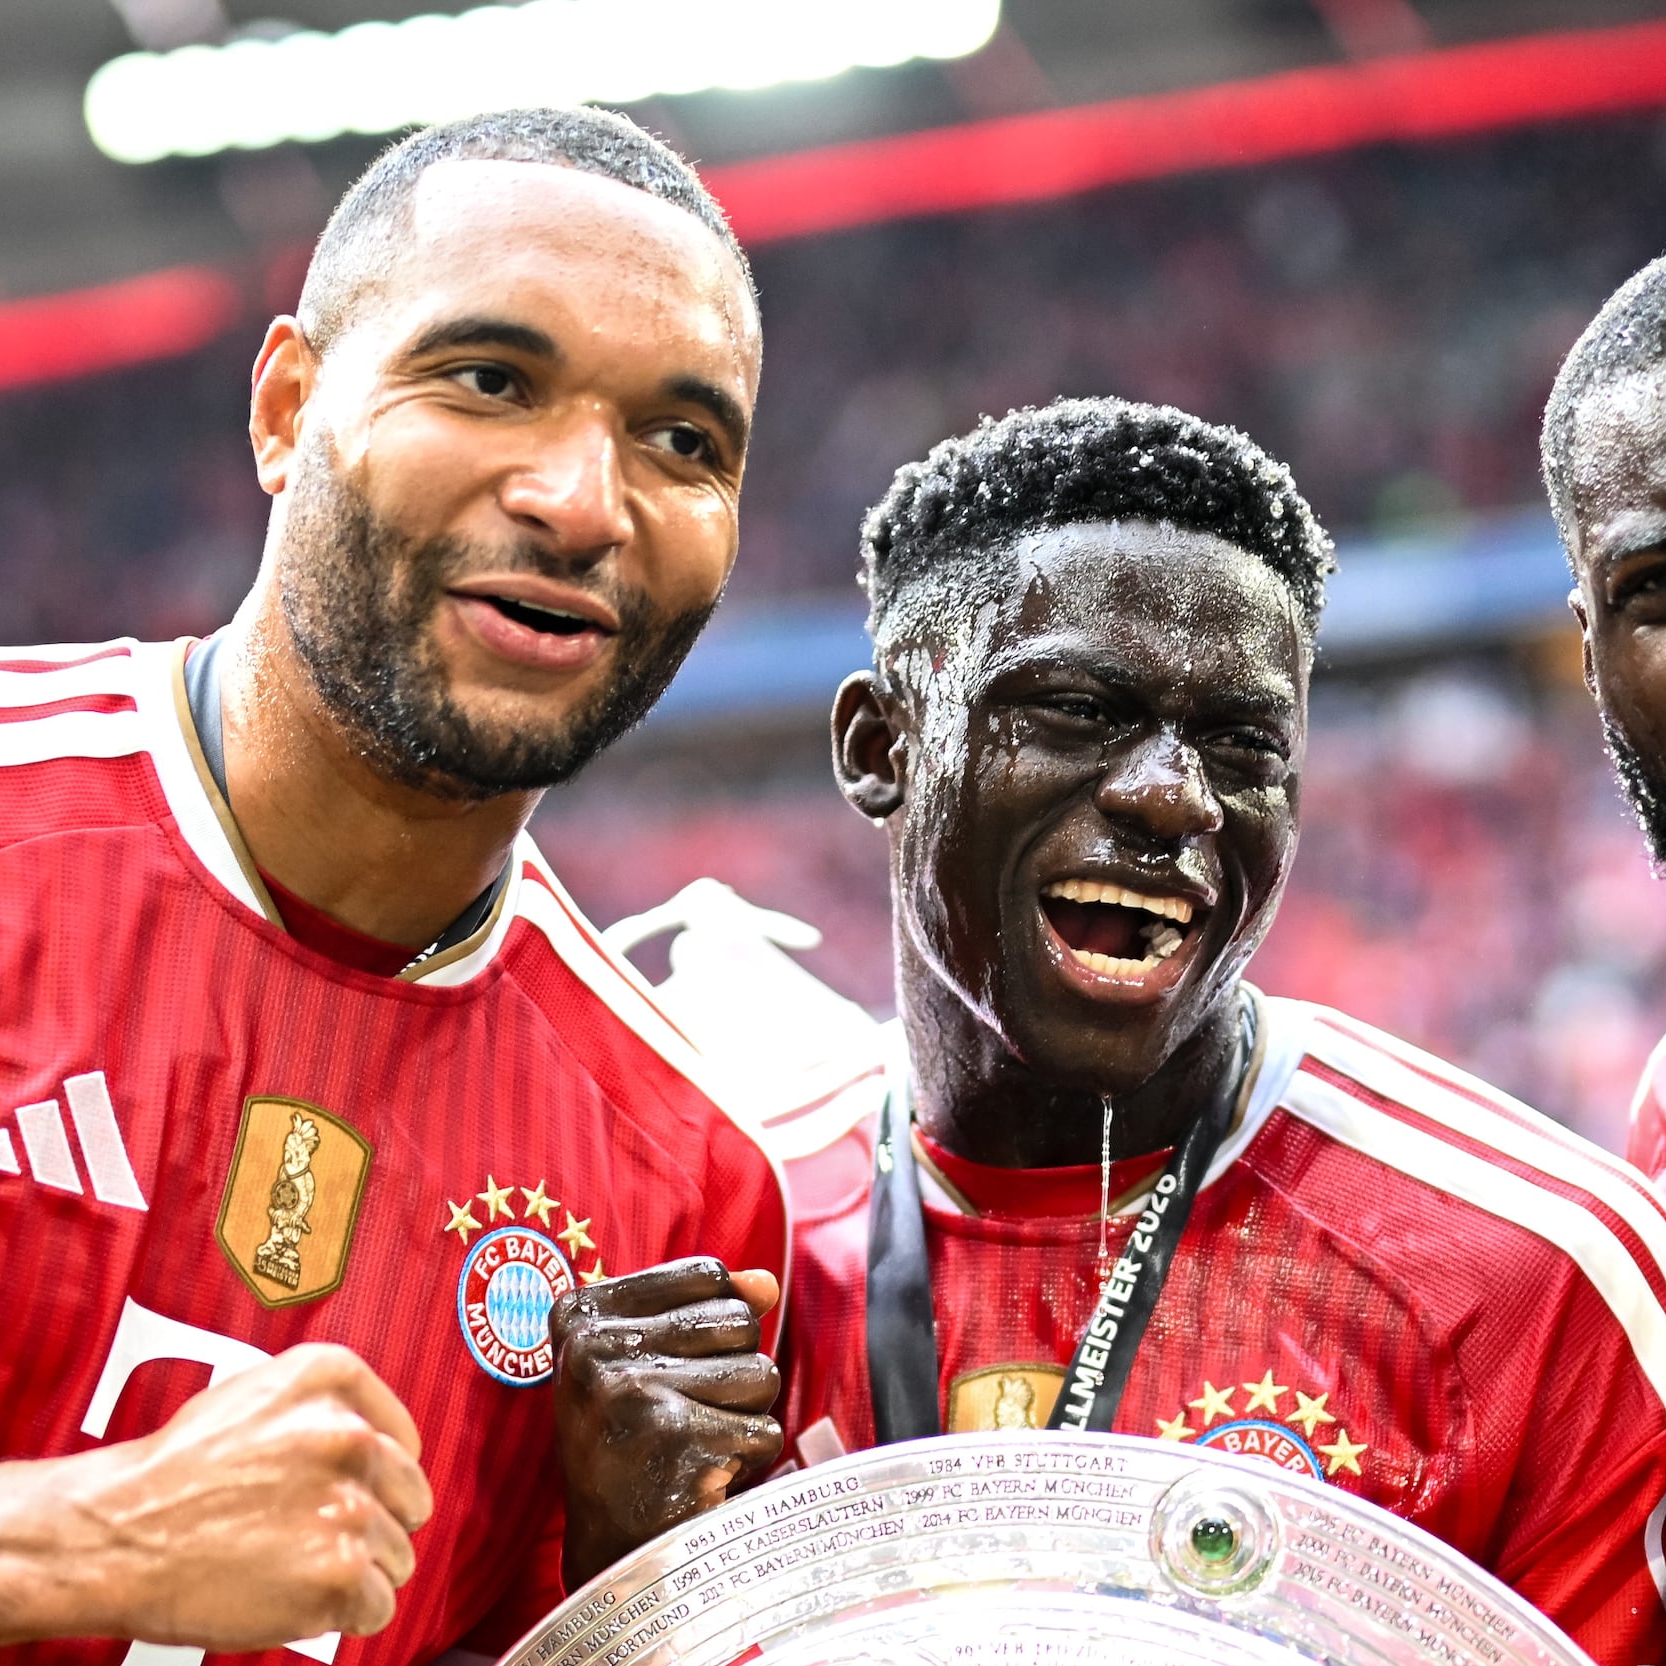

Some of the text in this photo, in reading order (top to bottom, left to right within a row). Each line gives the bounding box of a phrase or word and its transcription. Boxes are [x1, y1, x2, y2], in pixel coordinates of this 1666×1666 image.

[474, 1237, 567, 1302] FC BAYER
[1224, 1430, 1306, 1475] BAYER
[718, 1545, 740, 1566] FC
[743, 1495, 884, 1554] KAISERSLAUTERN
[721, 1509, 757, 1536] HSV
[763, 1475, 859, 1518] HAMBURG
[729, 1569, 751, 1589] FC
[753, 1542, 817, 1578] BAYERN
[534, 1588, 617, 1661] HAMBURG
[581, 1588, 660, 1652] MÜNCHEN
[603, 1601, 691, 1666] DORTMUND
